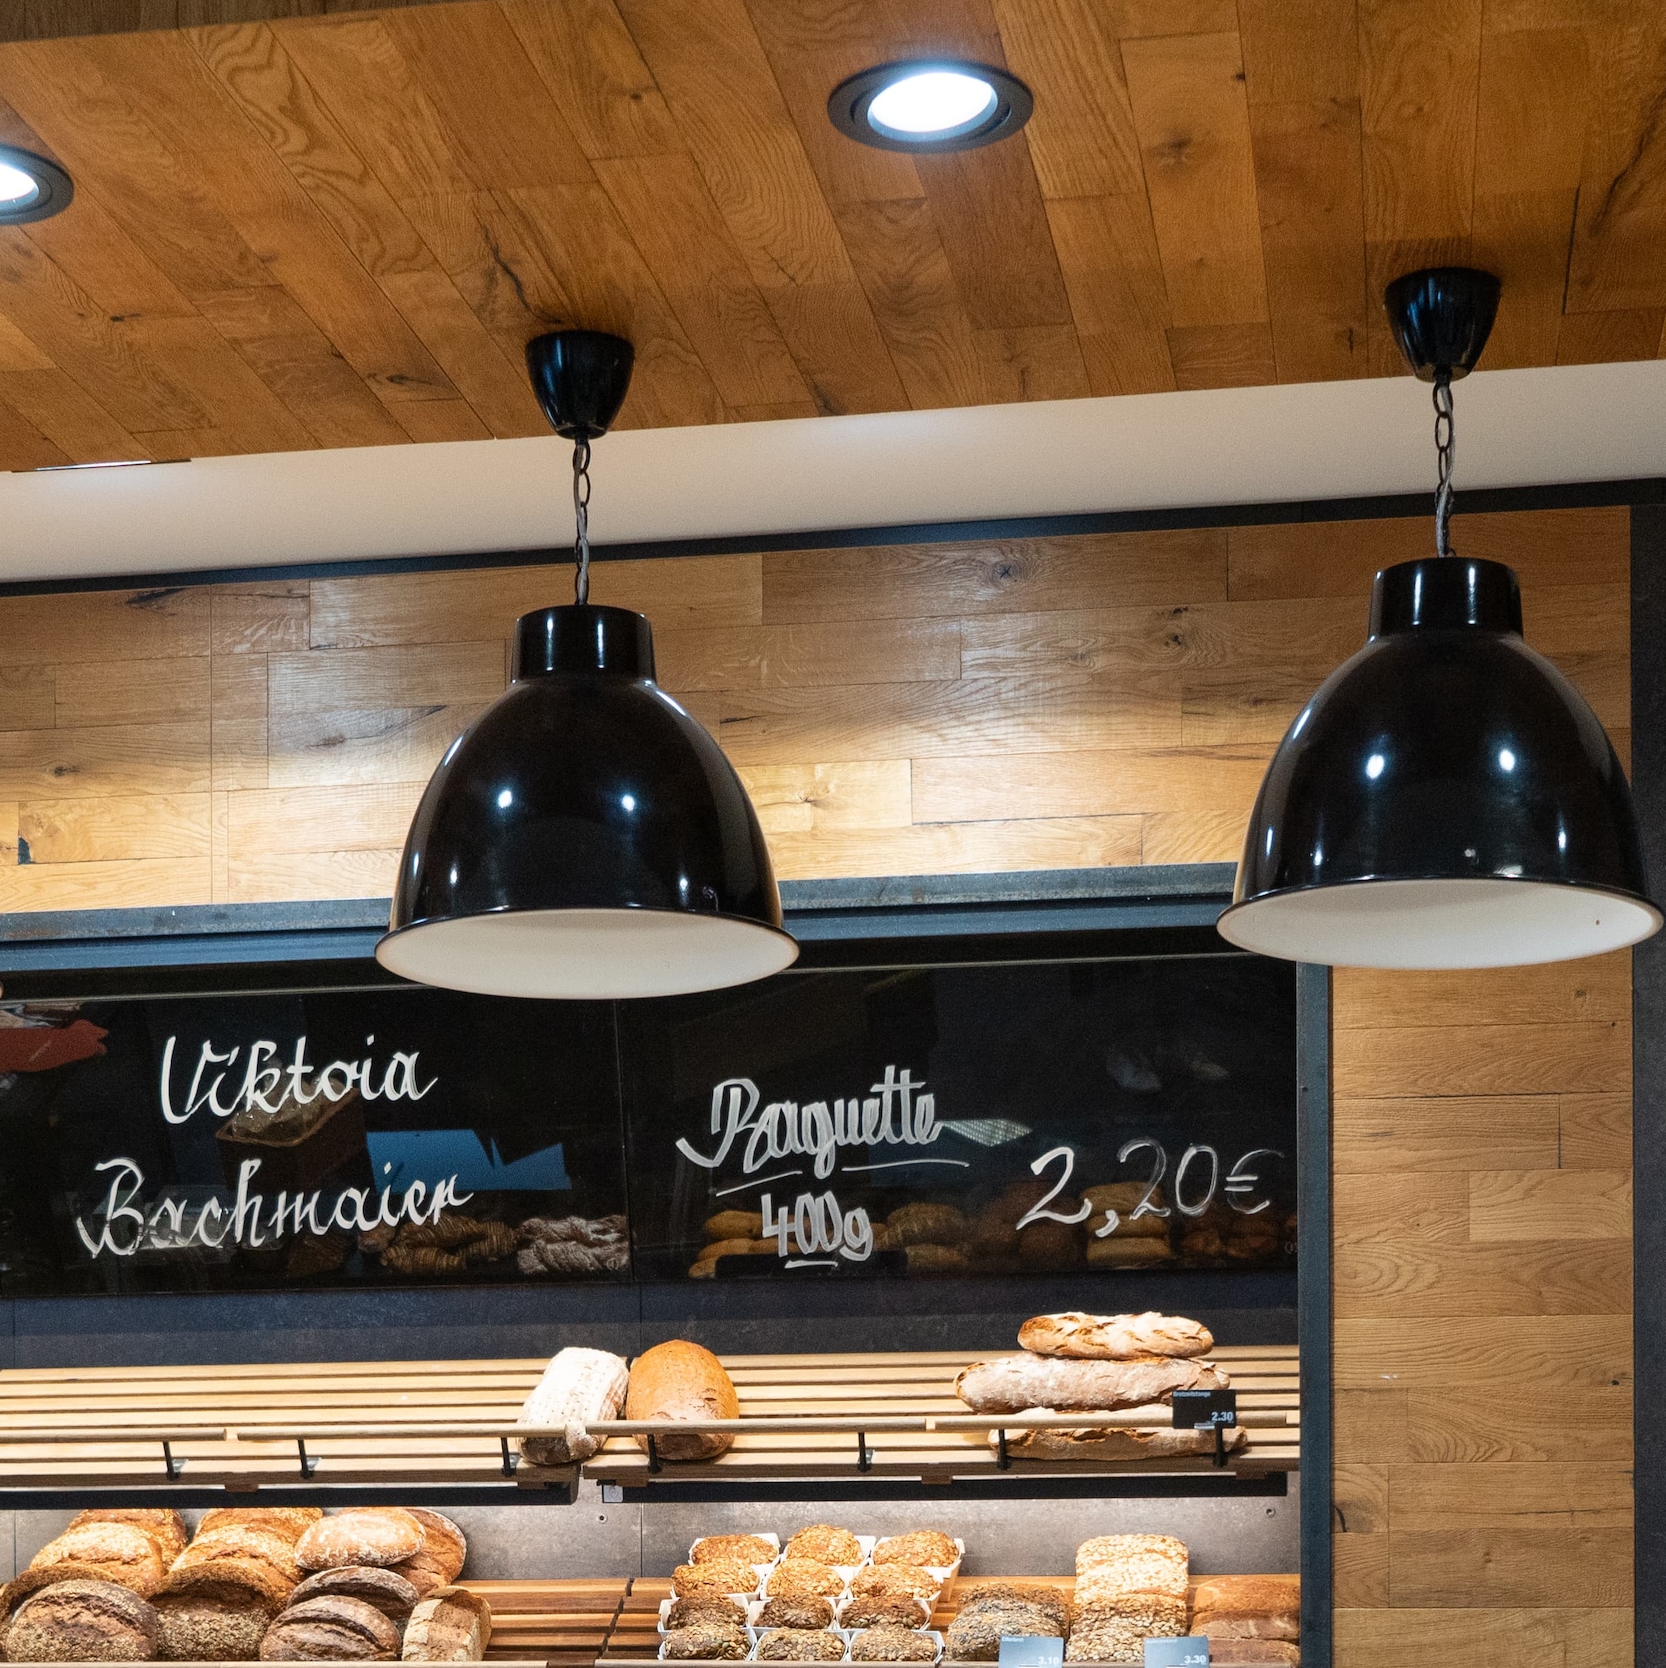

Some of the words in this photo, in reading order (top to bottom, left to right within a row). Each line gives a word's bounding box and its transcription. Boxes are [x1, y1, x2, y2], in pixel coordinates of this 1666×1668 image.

[676, 1065, 943, 1179] Baguette
[77, 1157, 473, 1259] Bachmaier
[761, 1191, 873, 1261] 400g
[1211, 1411, 1234, 1422] 2.30
[1037, 1656, 1060, 1666] 3.10
[1184, 1654, 1207, 1664] 3.30
